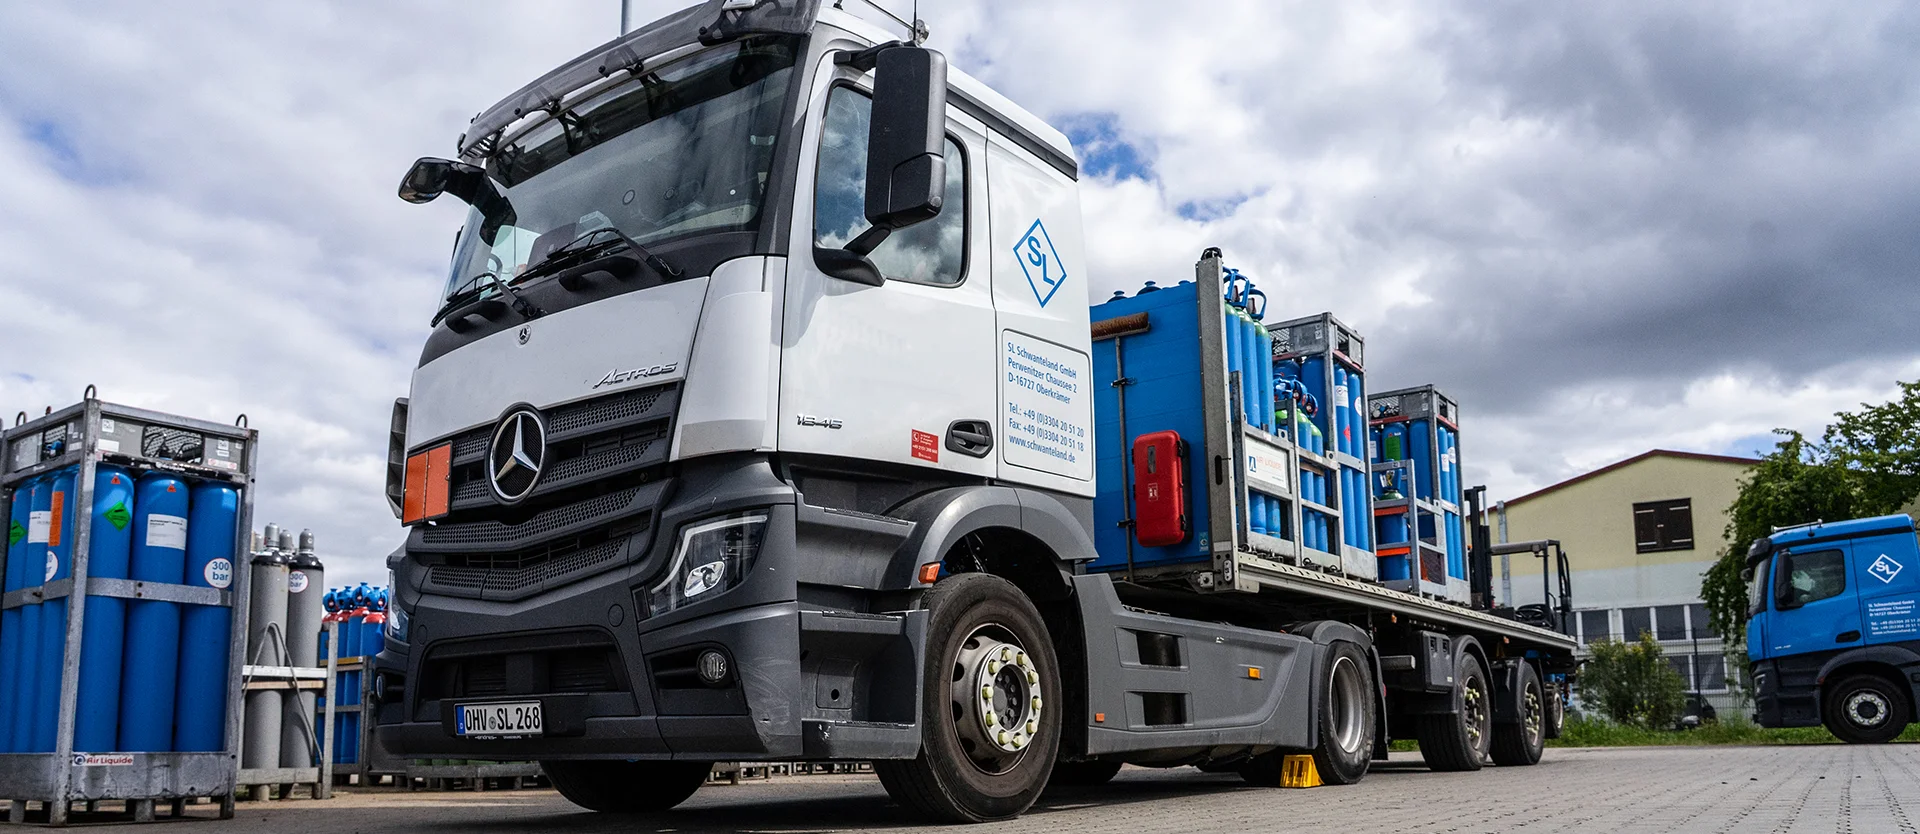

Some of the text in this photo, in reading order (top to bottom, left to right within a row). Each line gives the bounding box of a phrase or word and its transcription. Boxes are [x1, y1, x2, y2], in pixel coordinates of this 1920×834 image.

[1027, 235, 1055, 286] SL
[1007, 341, 1077, 379] SL Schwanteland GmbH
[1008, 357, 1077, 394] Perwenitzer Chaussee 2
[1008, 372, 1070, 404] D-16727 Oberkrämer
[1009, 402, 1084, 438] Tel.: +49 (0)3304 20 51 20
[1009, 417, 1084, 452] Fax: +49 (0)3304 20 51 18
[1008, 434, 1076, 463] www.schwanteland.de
[212, 561, 229, 571] 300
[212, 571, 229, 580] bar
[1875, 561, 1895, 574] SL
[465, 708, 487, 731] OHV
[496, 707, 513, 730] SL
[515, 706, 540, 730] 268
[101, 757, 132, 765] Liquide
